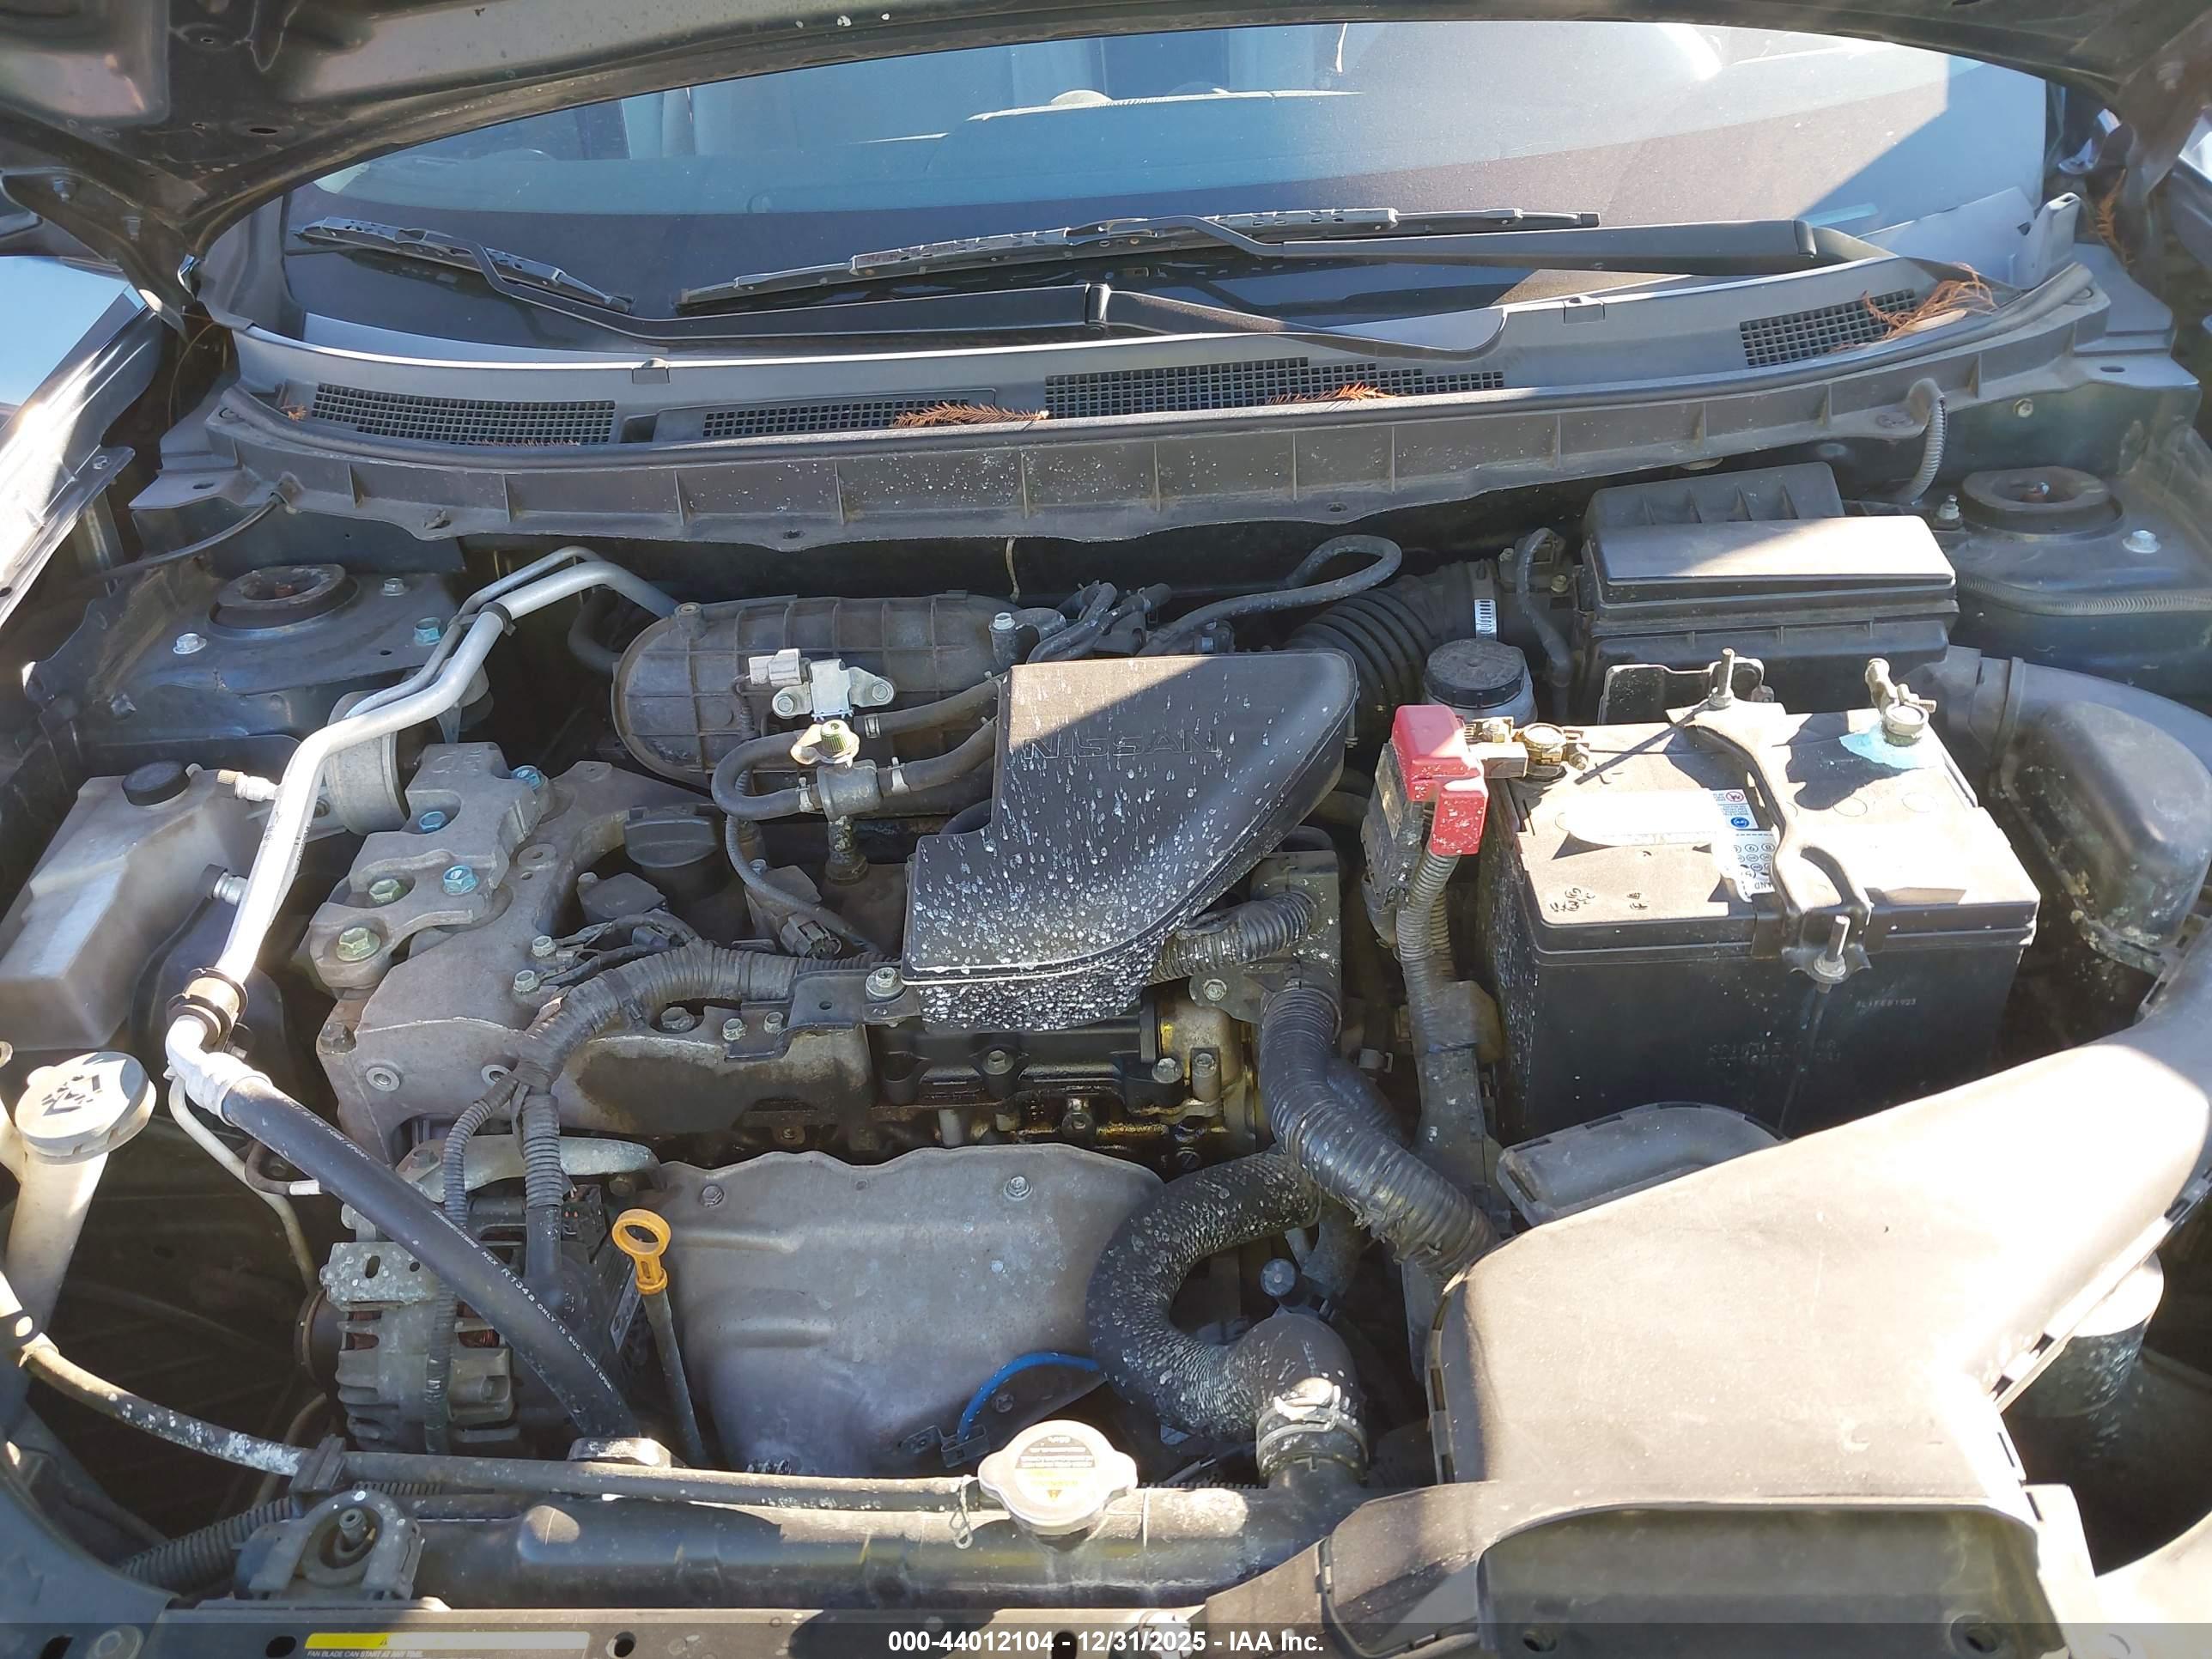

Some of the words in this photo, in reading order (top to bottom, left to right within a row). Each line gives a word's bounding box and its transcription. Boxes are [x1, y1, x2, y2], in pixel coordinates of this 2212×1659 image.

[1024, 730, 1219, 759] NISSAN
[481, 1250, 499, 1267] NEX
[501, 1267, 536, 1302] R134a
[537, 1304, 557, 1323] ONLY
[568, 1335, 581, 1352] SUC
